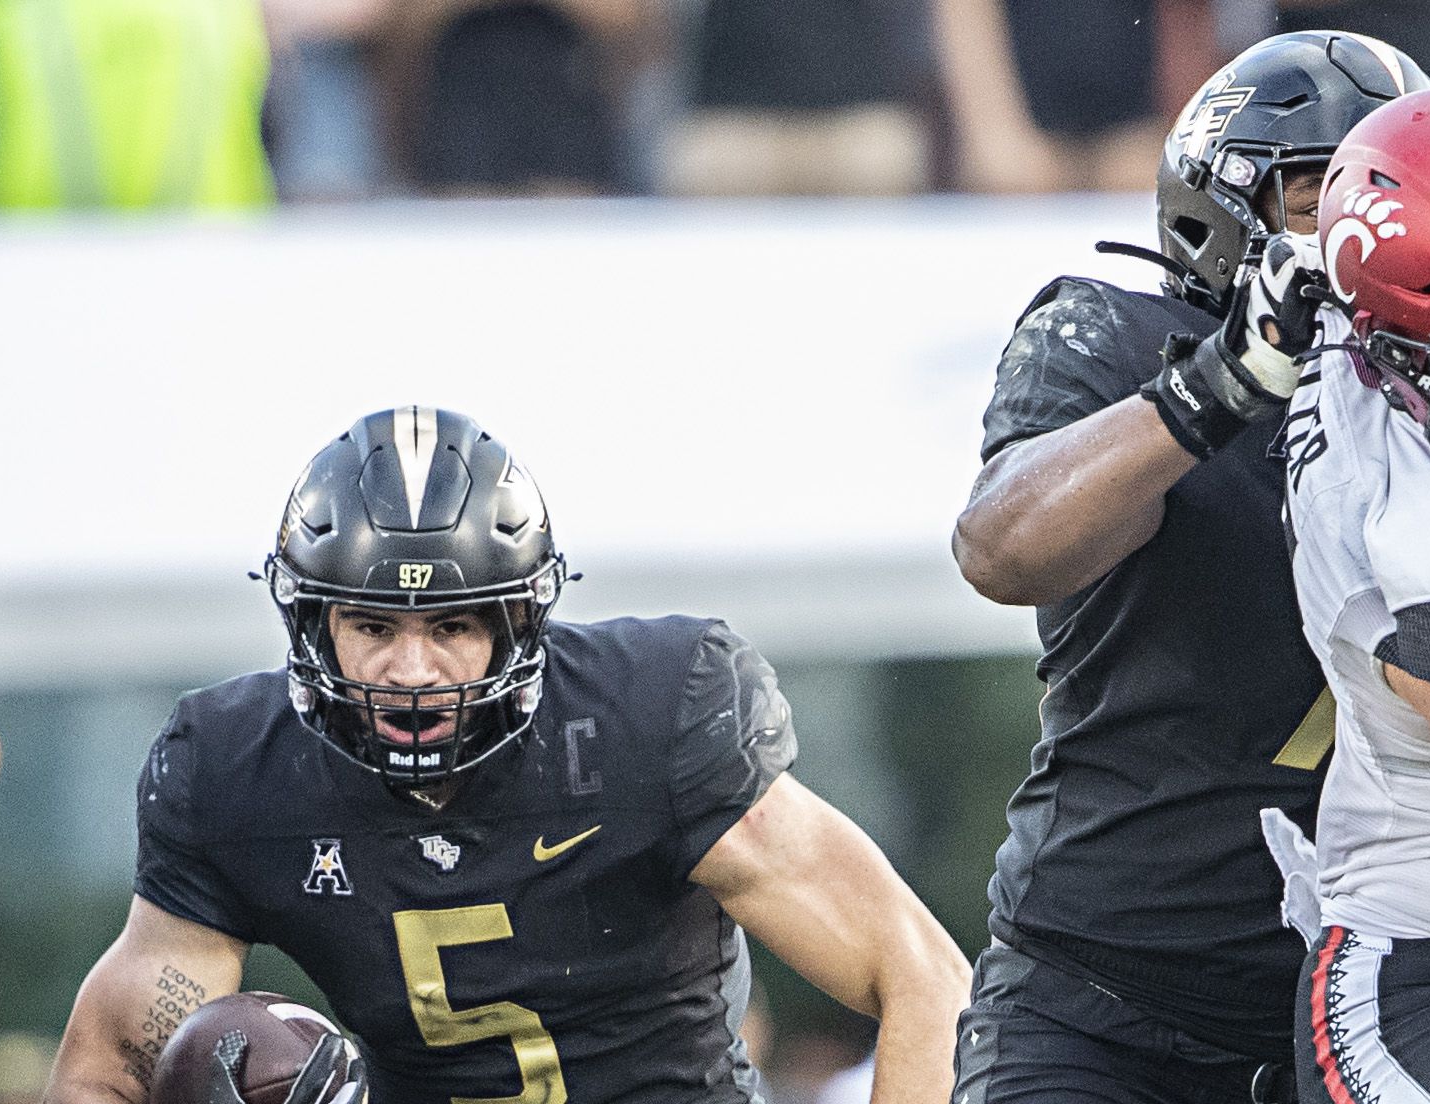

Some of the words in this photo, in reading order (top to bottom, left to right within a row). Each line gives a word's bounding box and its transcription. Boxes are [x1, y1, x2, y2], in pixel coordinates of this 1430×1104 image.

[399, 564, 434, 590] 937
[564, 717, 603, 796] C
[417, 834, 461, 871] UCF
